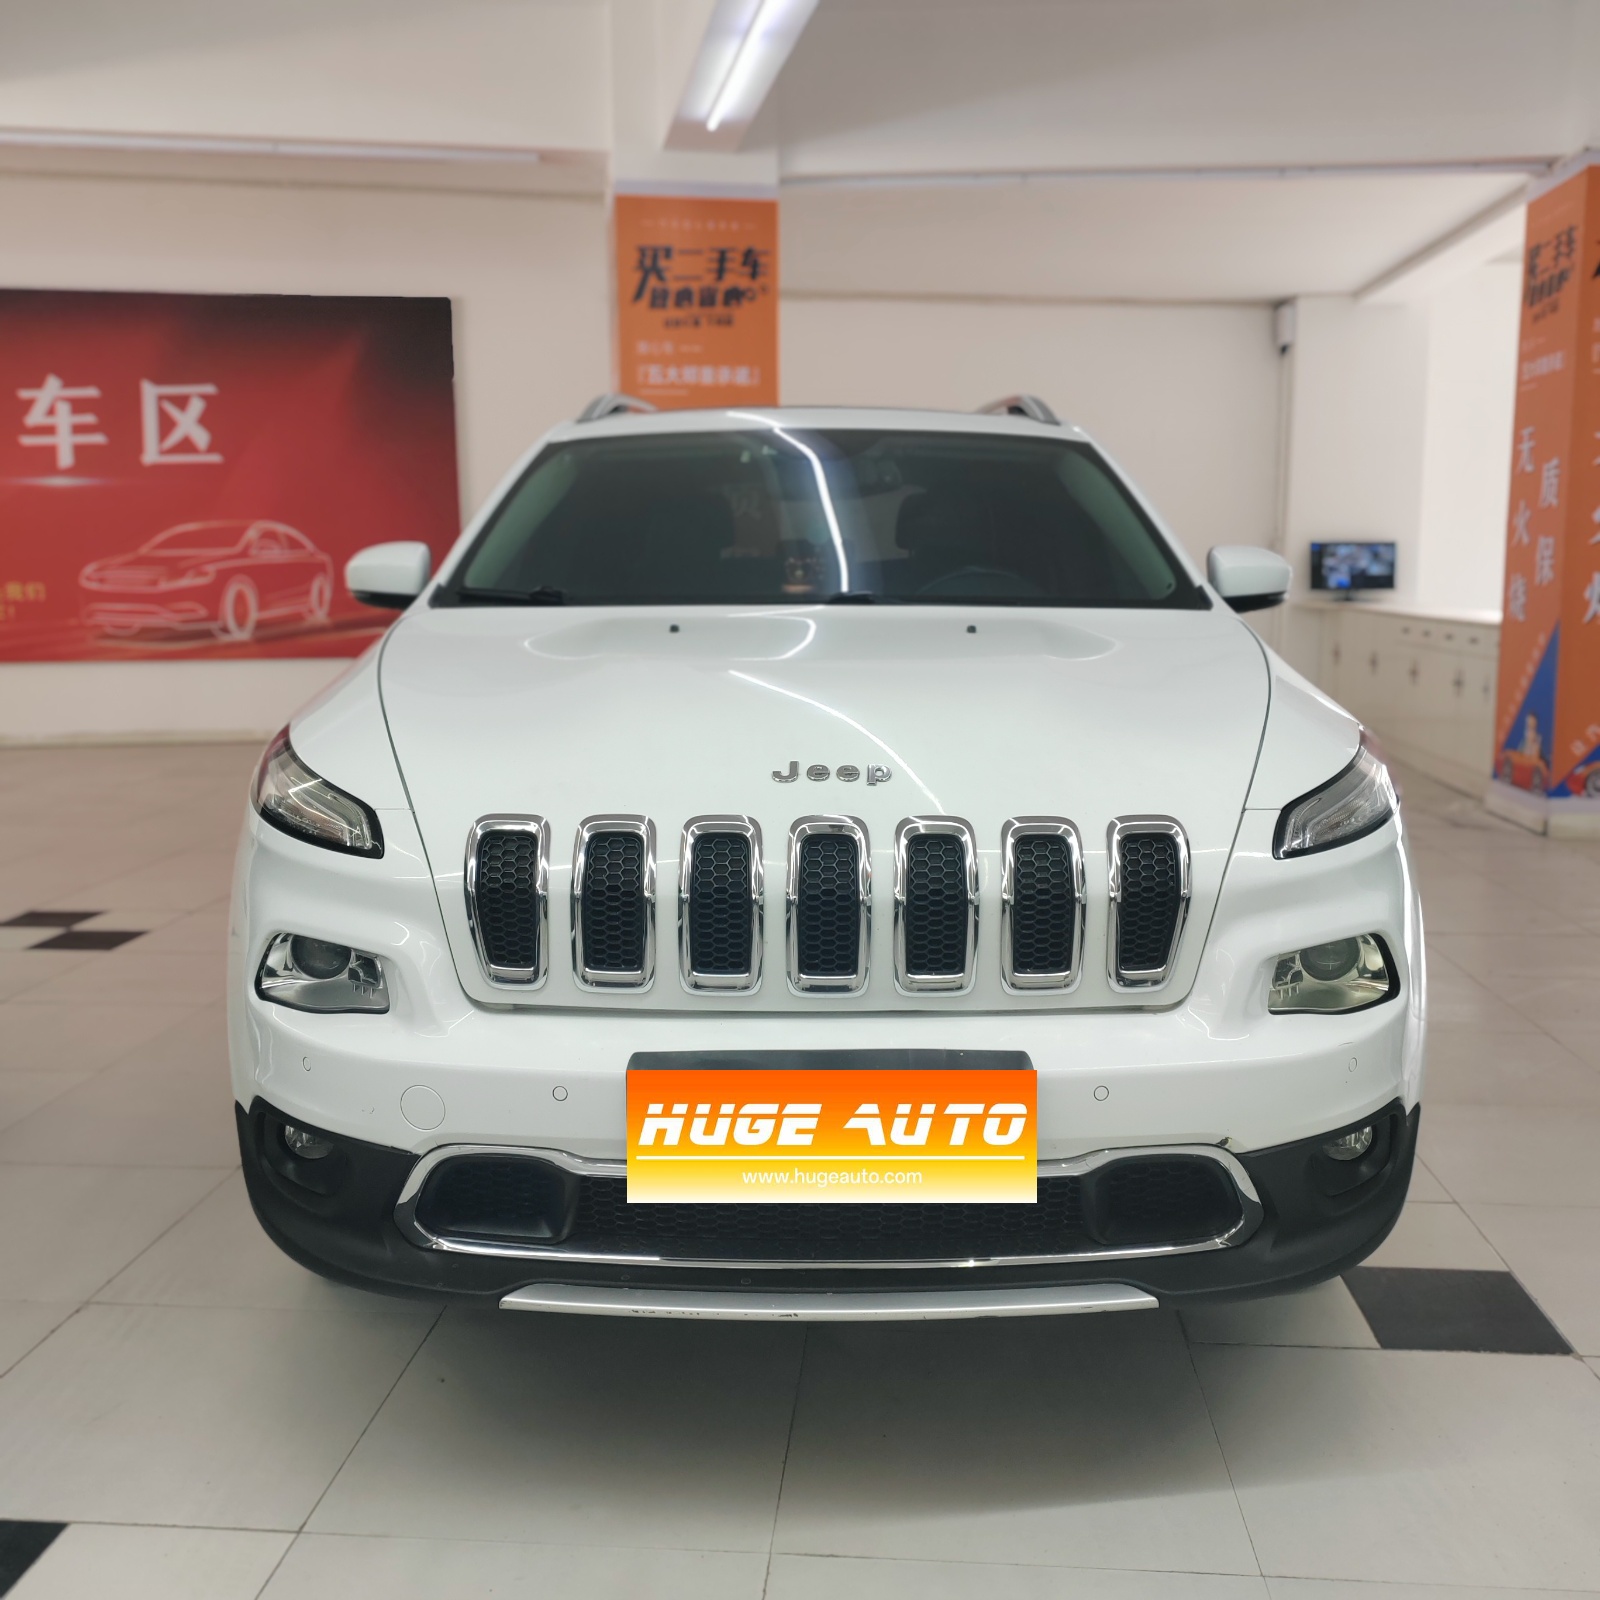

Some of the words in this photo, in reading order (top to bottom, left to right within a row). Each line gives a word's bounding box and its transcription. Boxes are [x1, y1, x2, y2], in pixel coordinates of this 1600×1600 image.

[633, 245, 770, 303] 买二手车
[16, 373, 224, 470] 车区
[772, 760, 892, 786] Jeep
